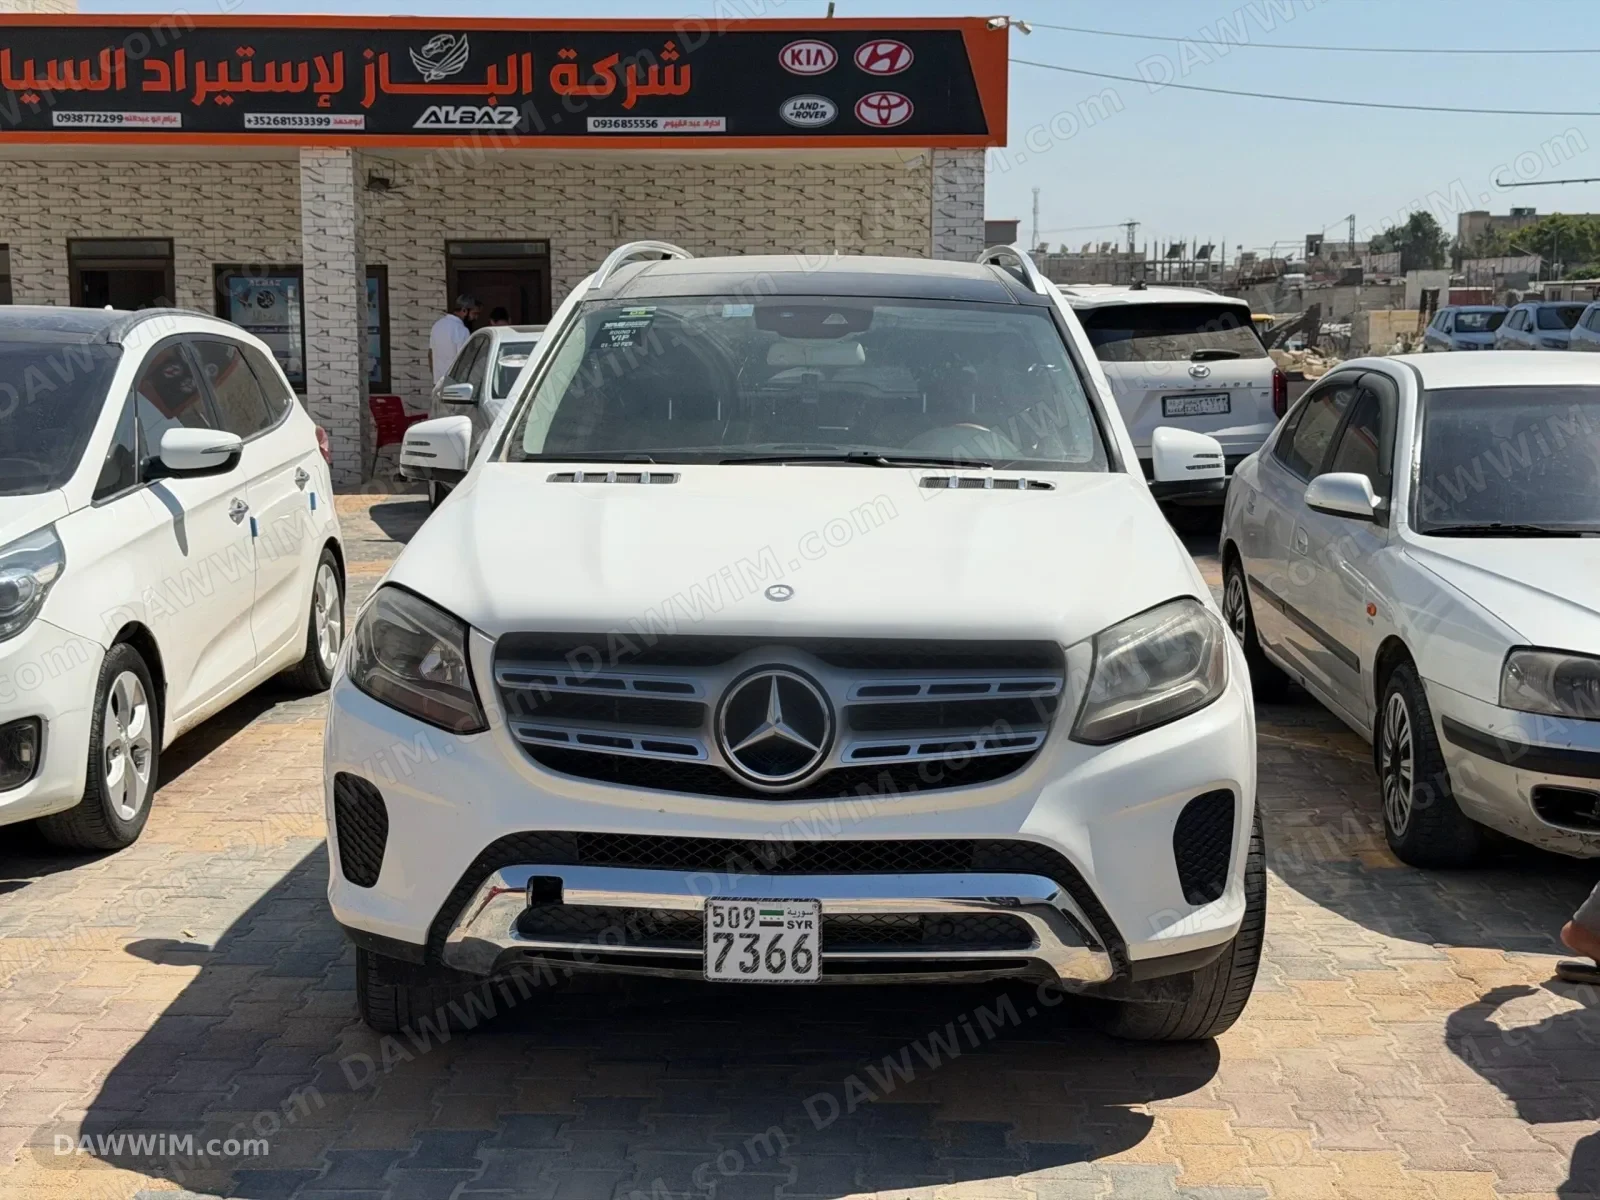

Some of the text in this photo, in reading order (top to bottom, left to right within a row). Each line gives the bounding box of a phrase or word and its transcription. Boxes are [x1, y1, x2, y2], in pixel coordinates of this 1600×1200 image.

[790, 49, 826, 66] KIA
[142, 46, 344, 108] لإستيراد
[360, 48, 532, 109] الباز
[550, 40, 691, 110] شركة
[56, 113, 124, 125] 0938772299
[246, 116, 331, 127] +352681533399
[419, 108, 516, 126] ALBAZ
[593, 119, 658, 129] 0936855556
[712, 905, 755, 929] 509
[787, 920, 813, 930] SYR
[712, 932, 813, 974] 7366
